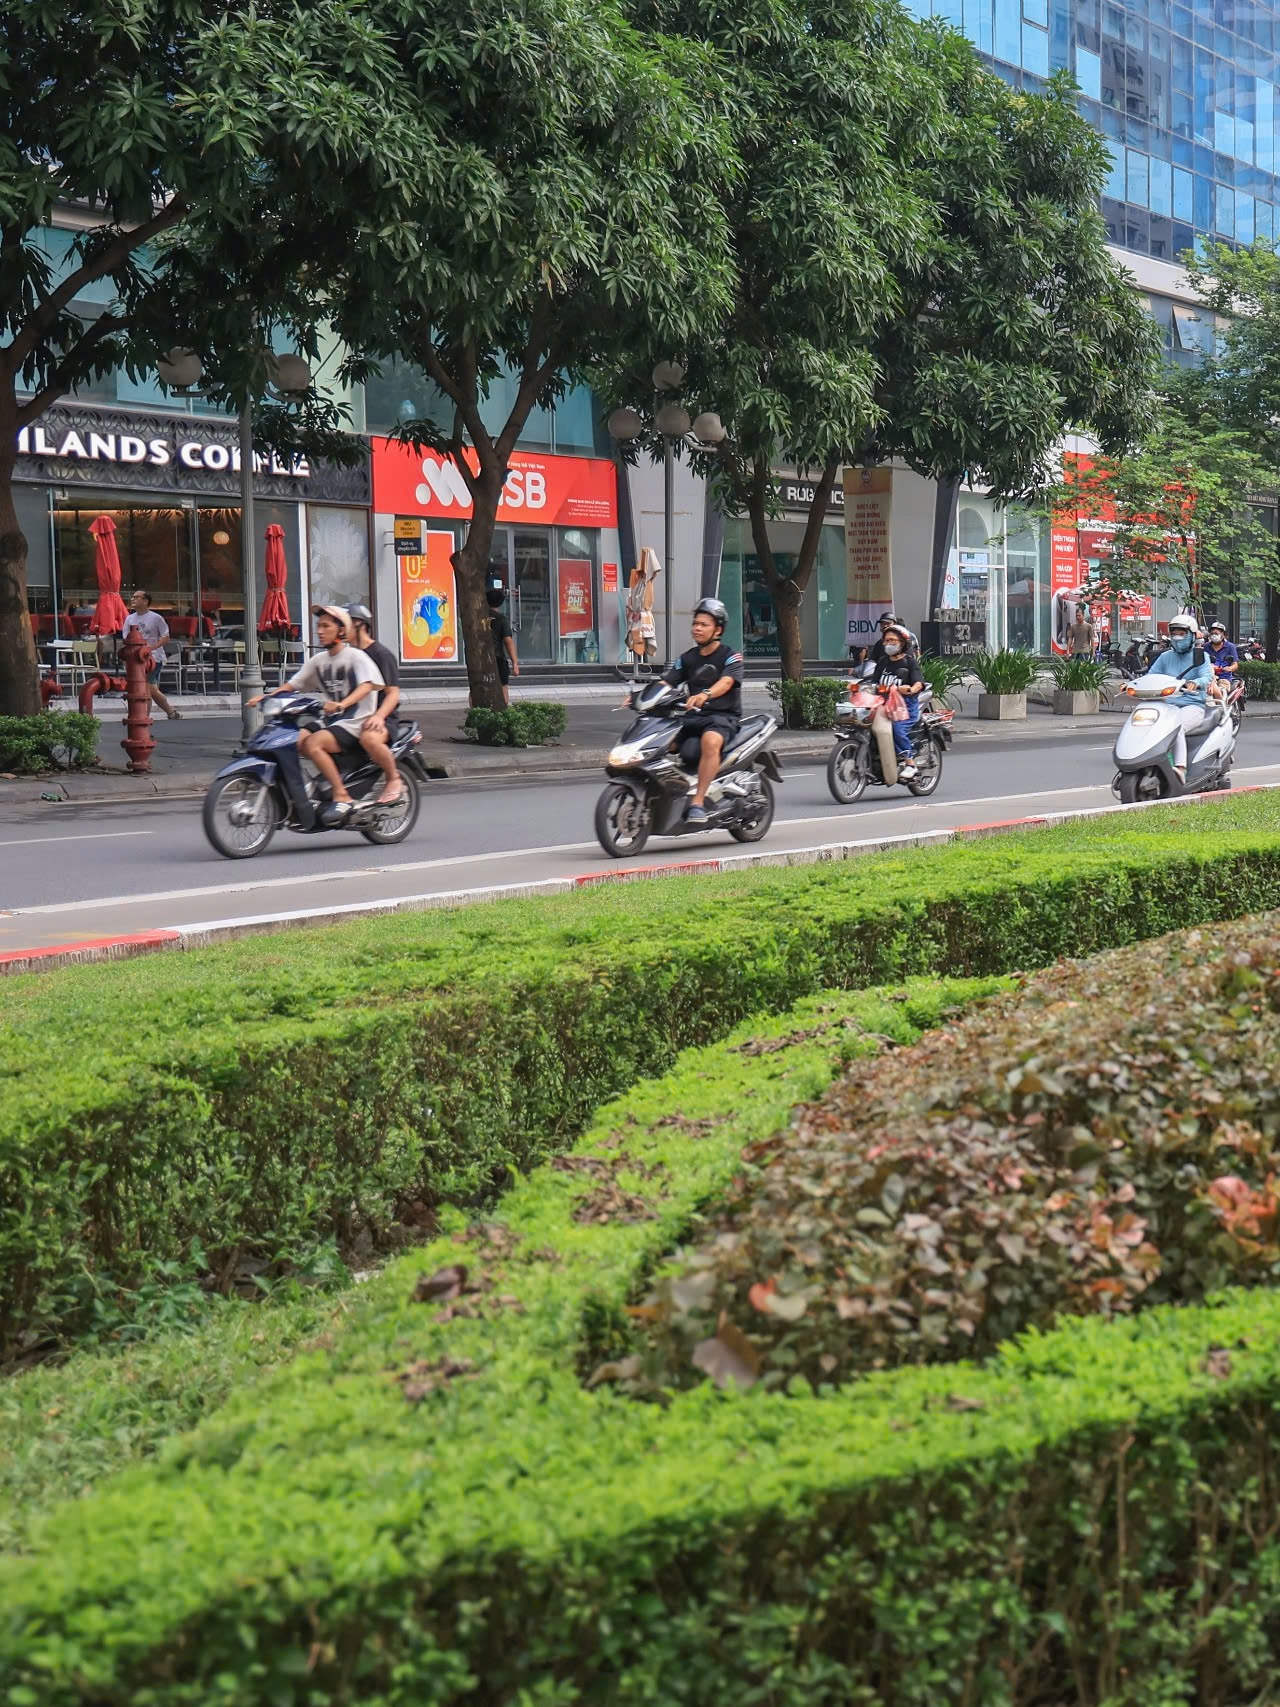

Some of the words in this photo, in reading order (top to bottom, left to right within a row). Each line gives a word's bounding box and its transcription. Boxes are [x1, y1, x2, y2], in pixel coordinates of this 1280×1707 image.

[498, 469, 547, 509] SB
[787, 486, 845, 504] ROBIC
[848, 620, 880, 633] BIDV
[955, 624, 971, 641] 23
